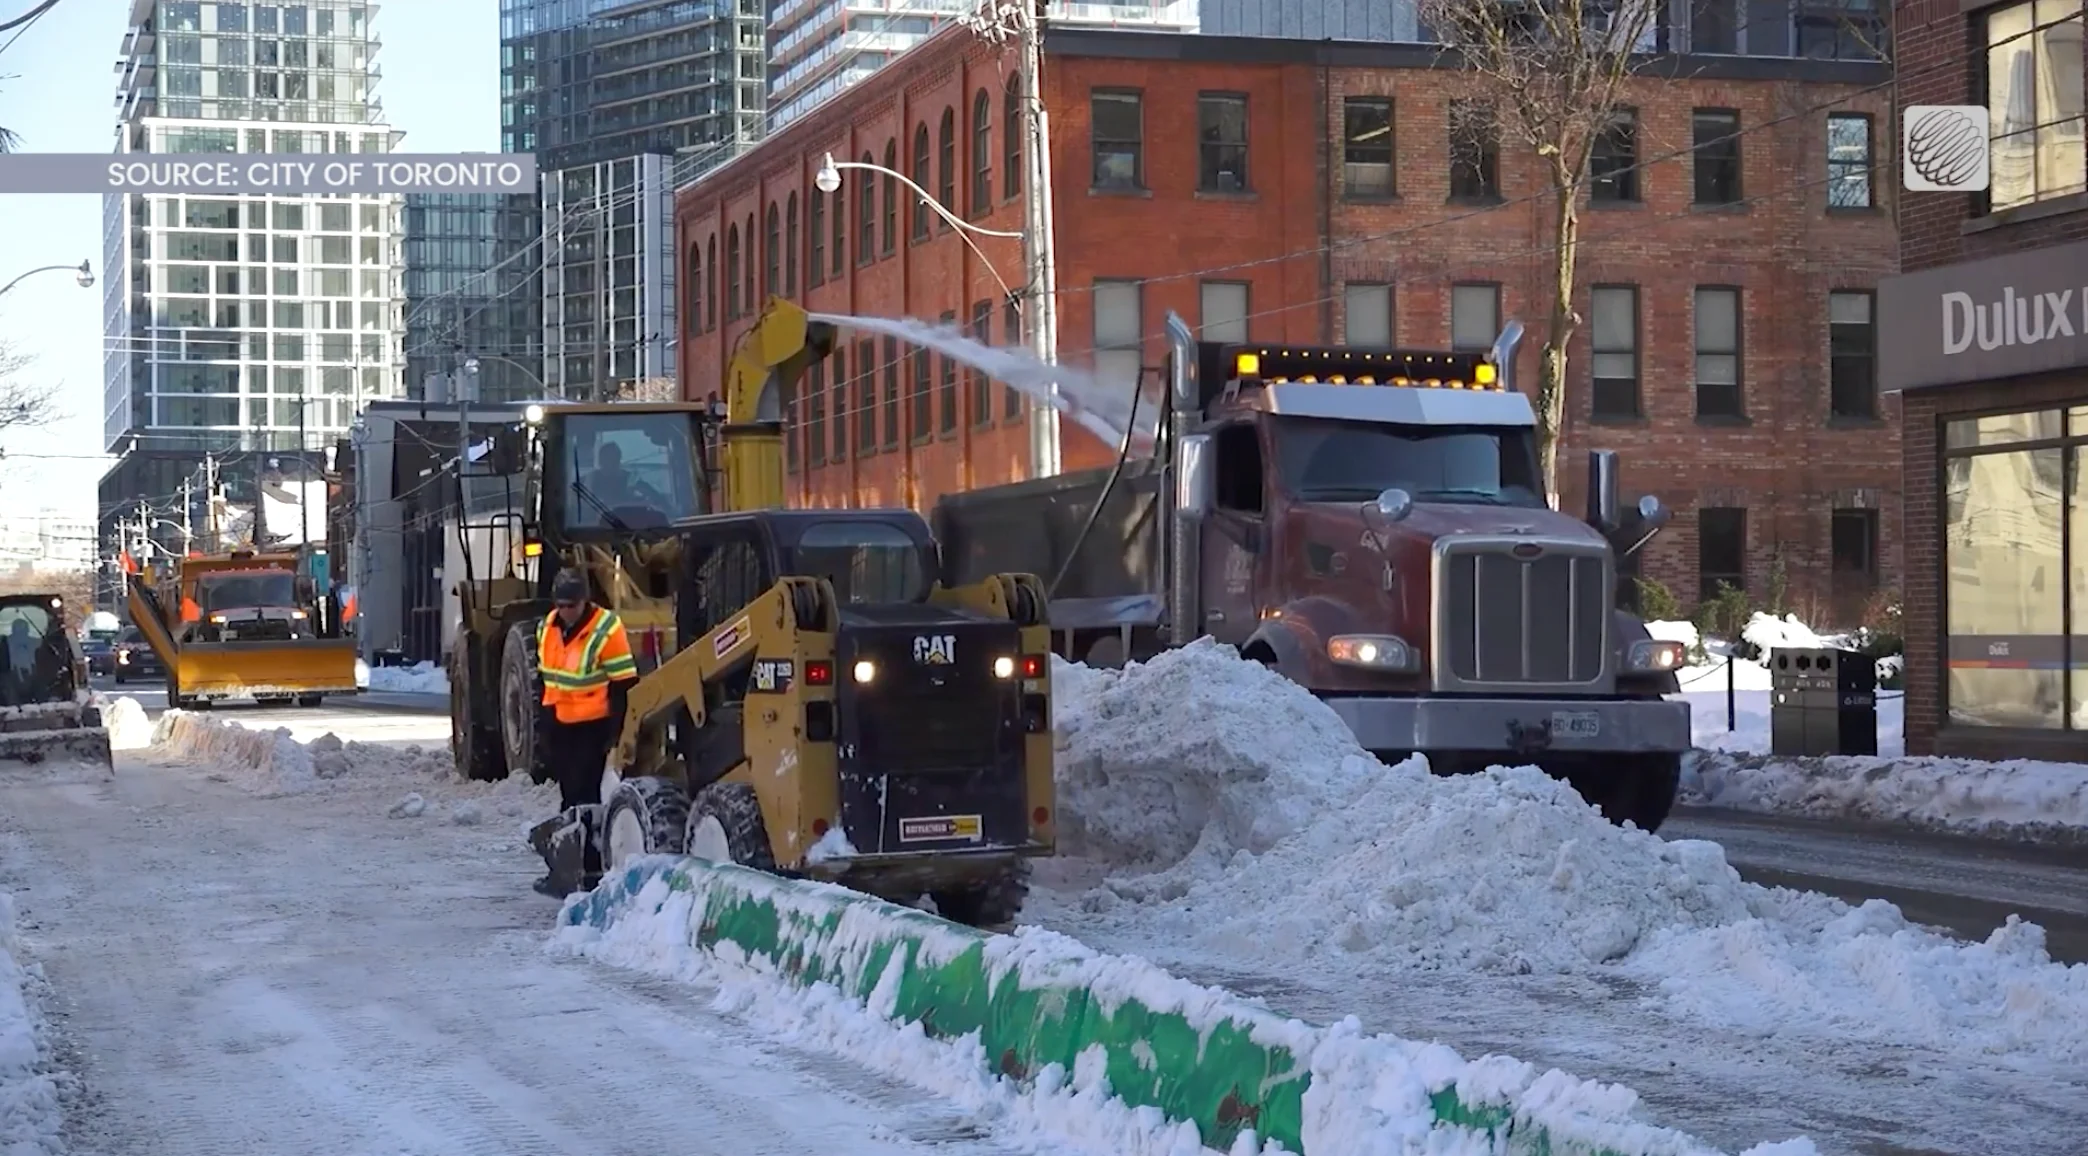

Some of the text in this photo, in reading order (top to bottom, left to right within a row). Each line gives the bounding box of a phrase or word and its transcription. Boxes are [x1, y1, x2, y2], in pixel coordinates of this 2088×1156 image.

[1941, 286, 2075, 355] Dulux
[913, 635, 957, 664] CAT
[757, 662, 776, 690] CAT
